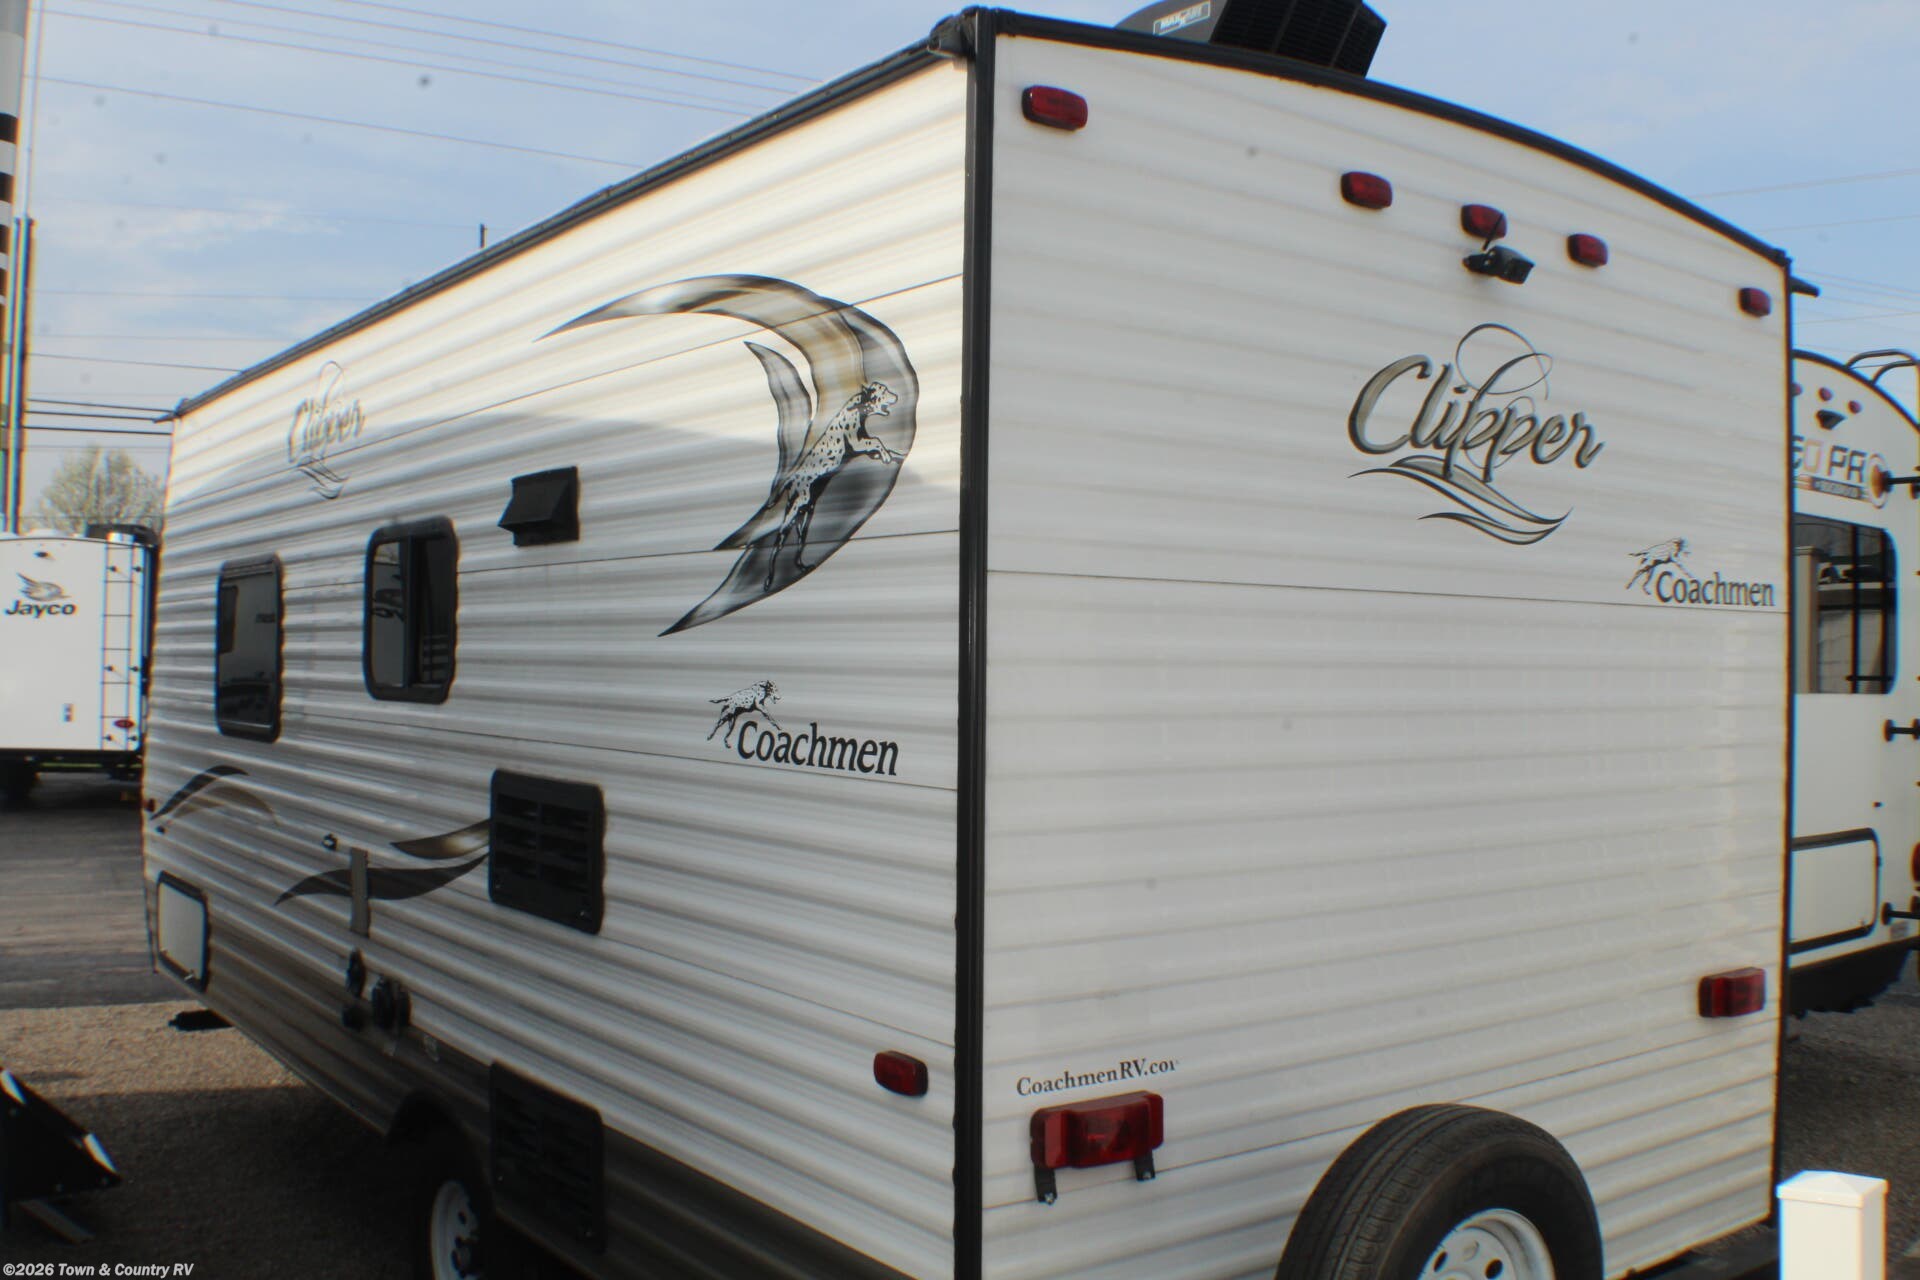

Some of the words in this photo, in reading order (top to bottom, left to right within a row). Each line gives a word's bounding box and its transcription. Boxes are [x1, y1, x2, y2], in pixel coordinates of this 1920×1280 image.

[1348, 323, 1605, 483] Clipper
[4, 600, 77, 619] Jayco
[1656, 571, 1775, 607] Coachmen
[737, 720, 899, 776] Coachmen
